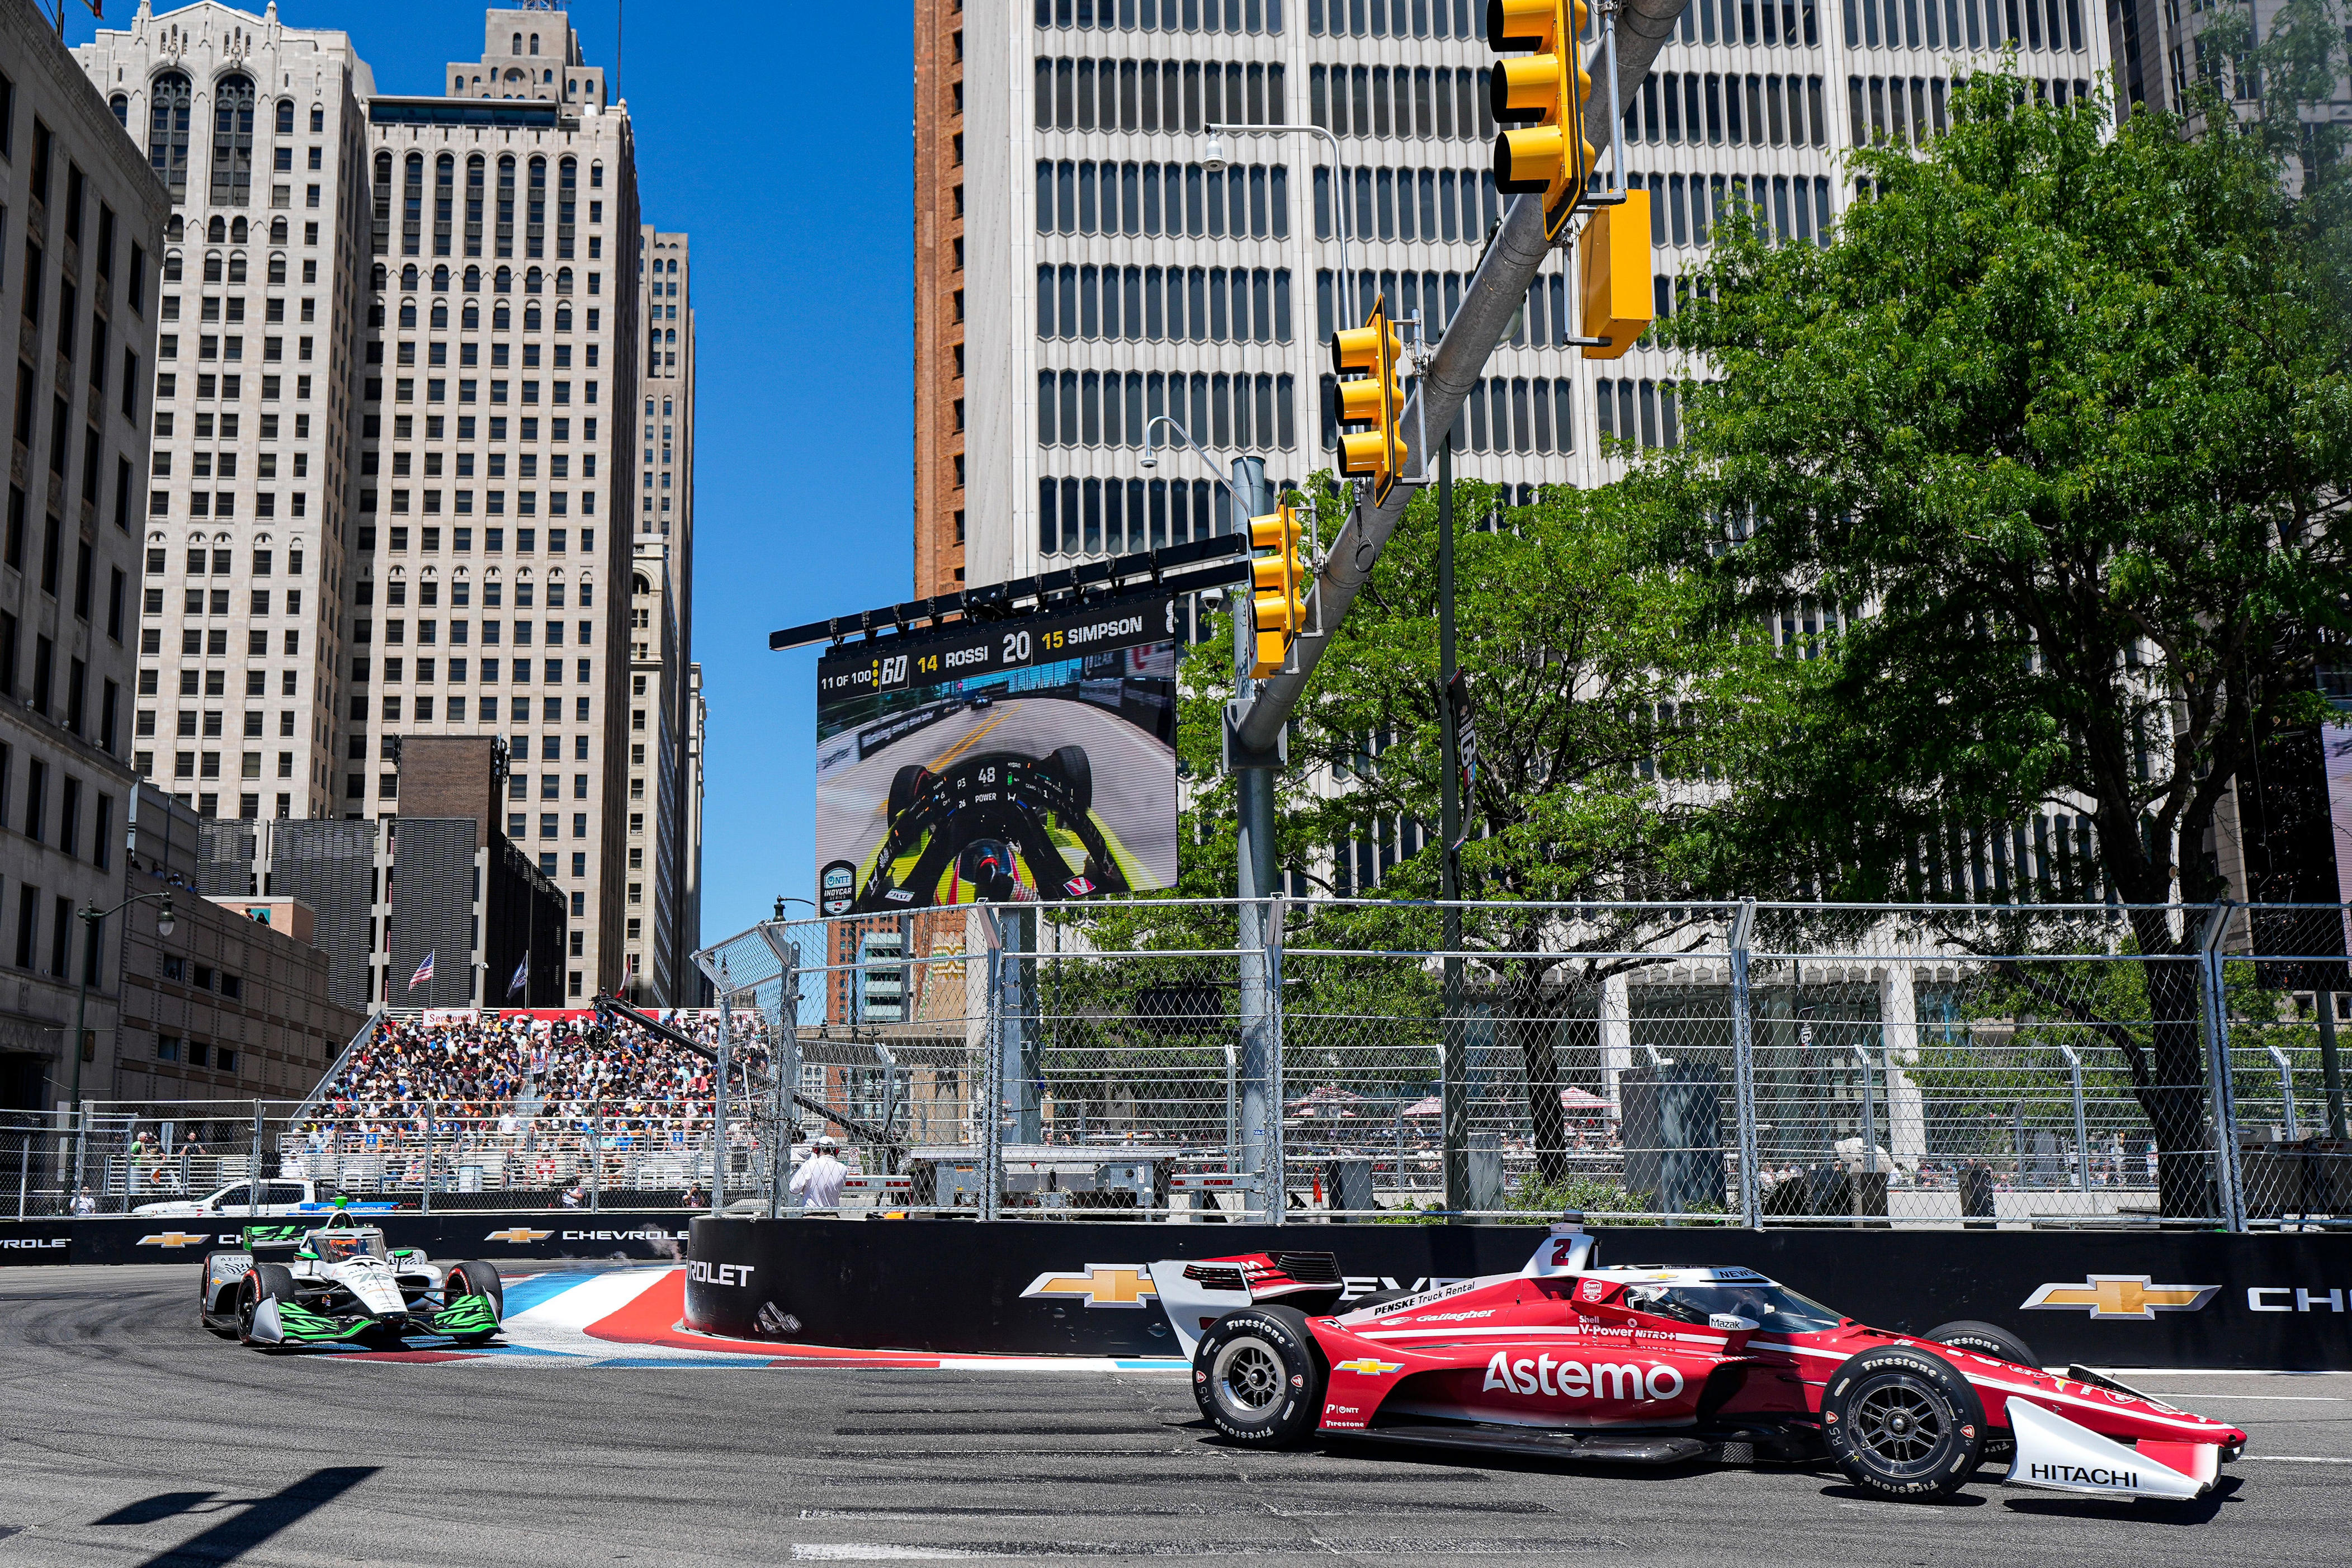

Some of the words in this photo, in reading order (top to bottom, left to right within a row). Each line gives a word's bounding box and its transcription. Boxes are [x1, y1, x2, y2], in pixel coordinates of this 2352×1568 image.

[1041, 630, 1063, 650] 15
[1068, 616, 1142, 644] SIMPSON
[1003, 630, 1031, 664] 20
[917, 655, 938, 673] 14
[945, 645, 989, 668] ROSSI
[821, 678, 833, 689] 11
[836, 675, 849, 687] OF
[851, 670, 871, 684] 100
[1458, 718, 1474, 738] DETROIT
[1460, 729, 1476, 767] GP
[957, 777, 966, 789] P3
[978, 767, 995, 783] 48
[975, 792, 997, 803] POWER
[824, 887, 852, 897] INDYCAR
[429, 1014, 463, 1022] Secon
[466, 1013, 472, 1022] A
[0, 1239, 72, 1249] ROLE
[563, 1230, 688, 1240] CHEVROLE
[1551, 1238, 1572, 1266] 2
[1374, 1297, 1415, 1315] PENSKE
[1419, 1291, 1443, 1304] Truck
[1446, 1281, 1475, 1297] Rental
[2247, 1287, 2352, 1312] CH
[1416, 1309, 1496, 1322] Gallagher
[1711, 1319, 1740, 1329] Mazak
[1226, 1319, 1286, 1345] Firestone
[1579, 1324, 1634, 1337] V-Power
[1939, 1336, 2000, 1352] restone
[1482, 1351, 1684, 1400] Astemo
[1861, 1357, 1937, 1377] Firestone
[1215, 1418, 1274, 1439] Firestone
[1864, 1475, 1939, 1494] Firestone
[2031, 1463, 2138, 1488] HITACHI
